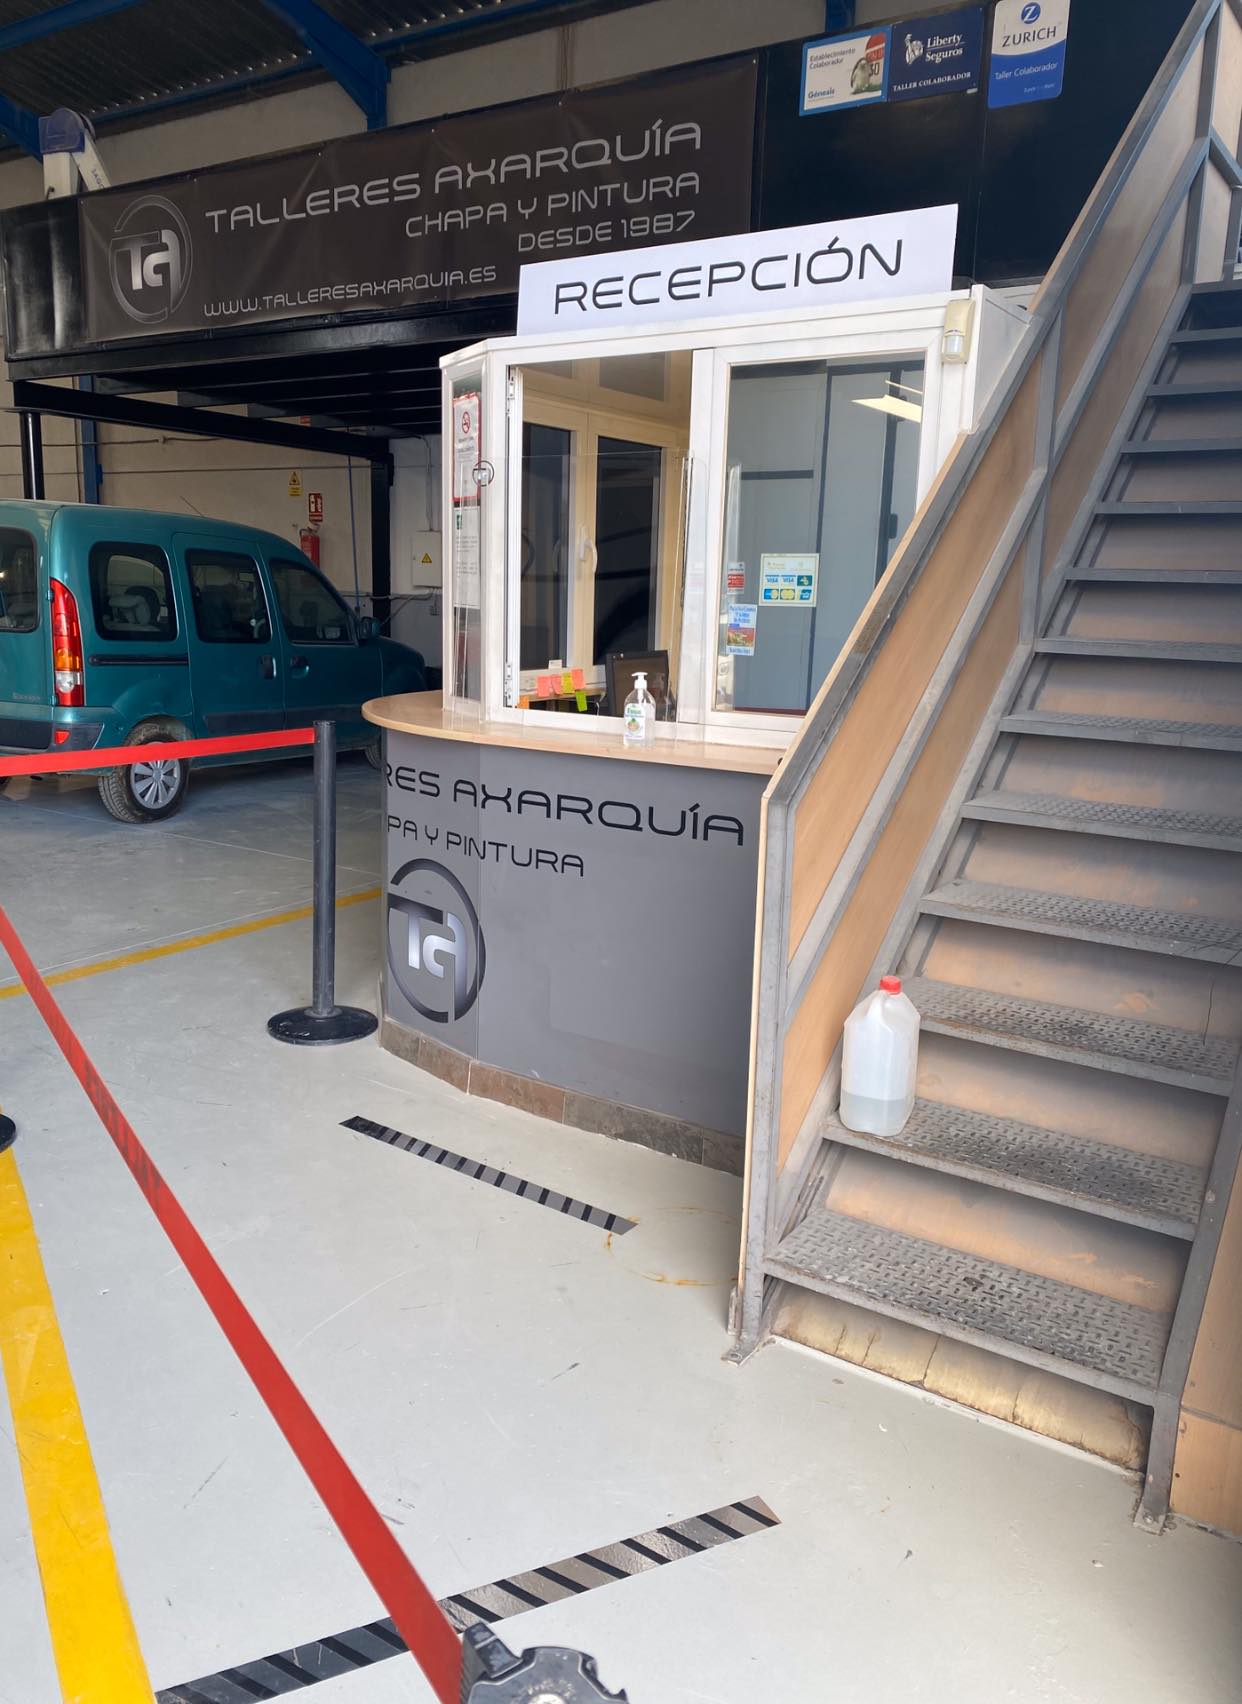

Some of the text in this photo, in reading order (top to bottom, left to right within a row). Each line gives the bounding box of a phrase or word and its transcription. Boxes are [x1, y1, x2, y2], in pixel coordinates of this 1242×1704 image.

[925, 47, 964, 63] Seguros
[927, 33, 963, 48] Liberty
[1002, 26, 1057, 48] ZURICH
[809, 57, 844, 70] Colaborador
[892, 71, 972, 92] TALLER COLABORADOR
[994, 62, 1059, 80] Taller Colaborador
[204, 118, 702, 233] TALLERES AXARQUÍA
[405, 171, 701, 239] CHAPA Y PINTURA
[517, 210, 696, 253] DESDE 1987
[203, 265, 498, 317] WWW.TALLERESAXARQUIA.ES
[554, 236, 903, 315] RECEPCIÓN
[453, 779, 744, 846] AXARQUÍA
[424, 825, 439, 846] Y
[446, 831, 584, 878] PINTURA
